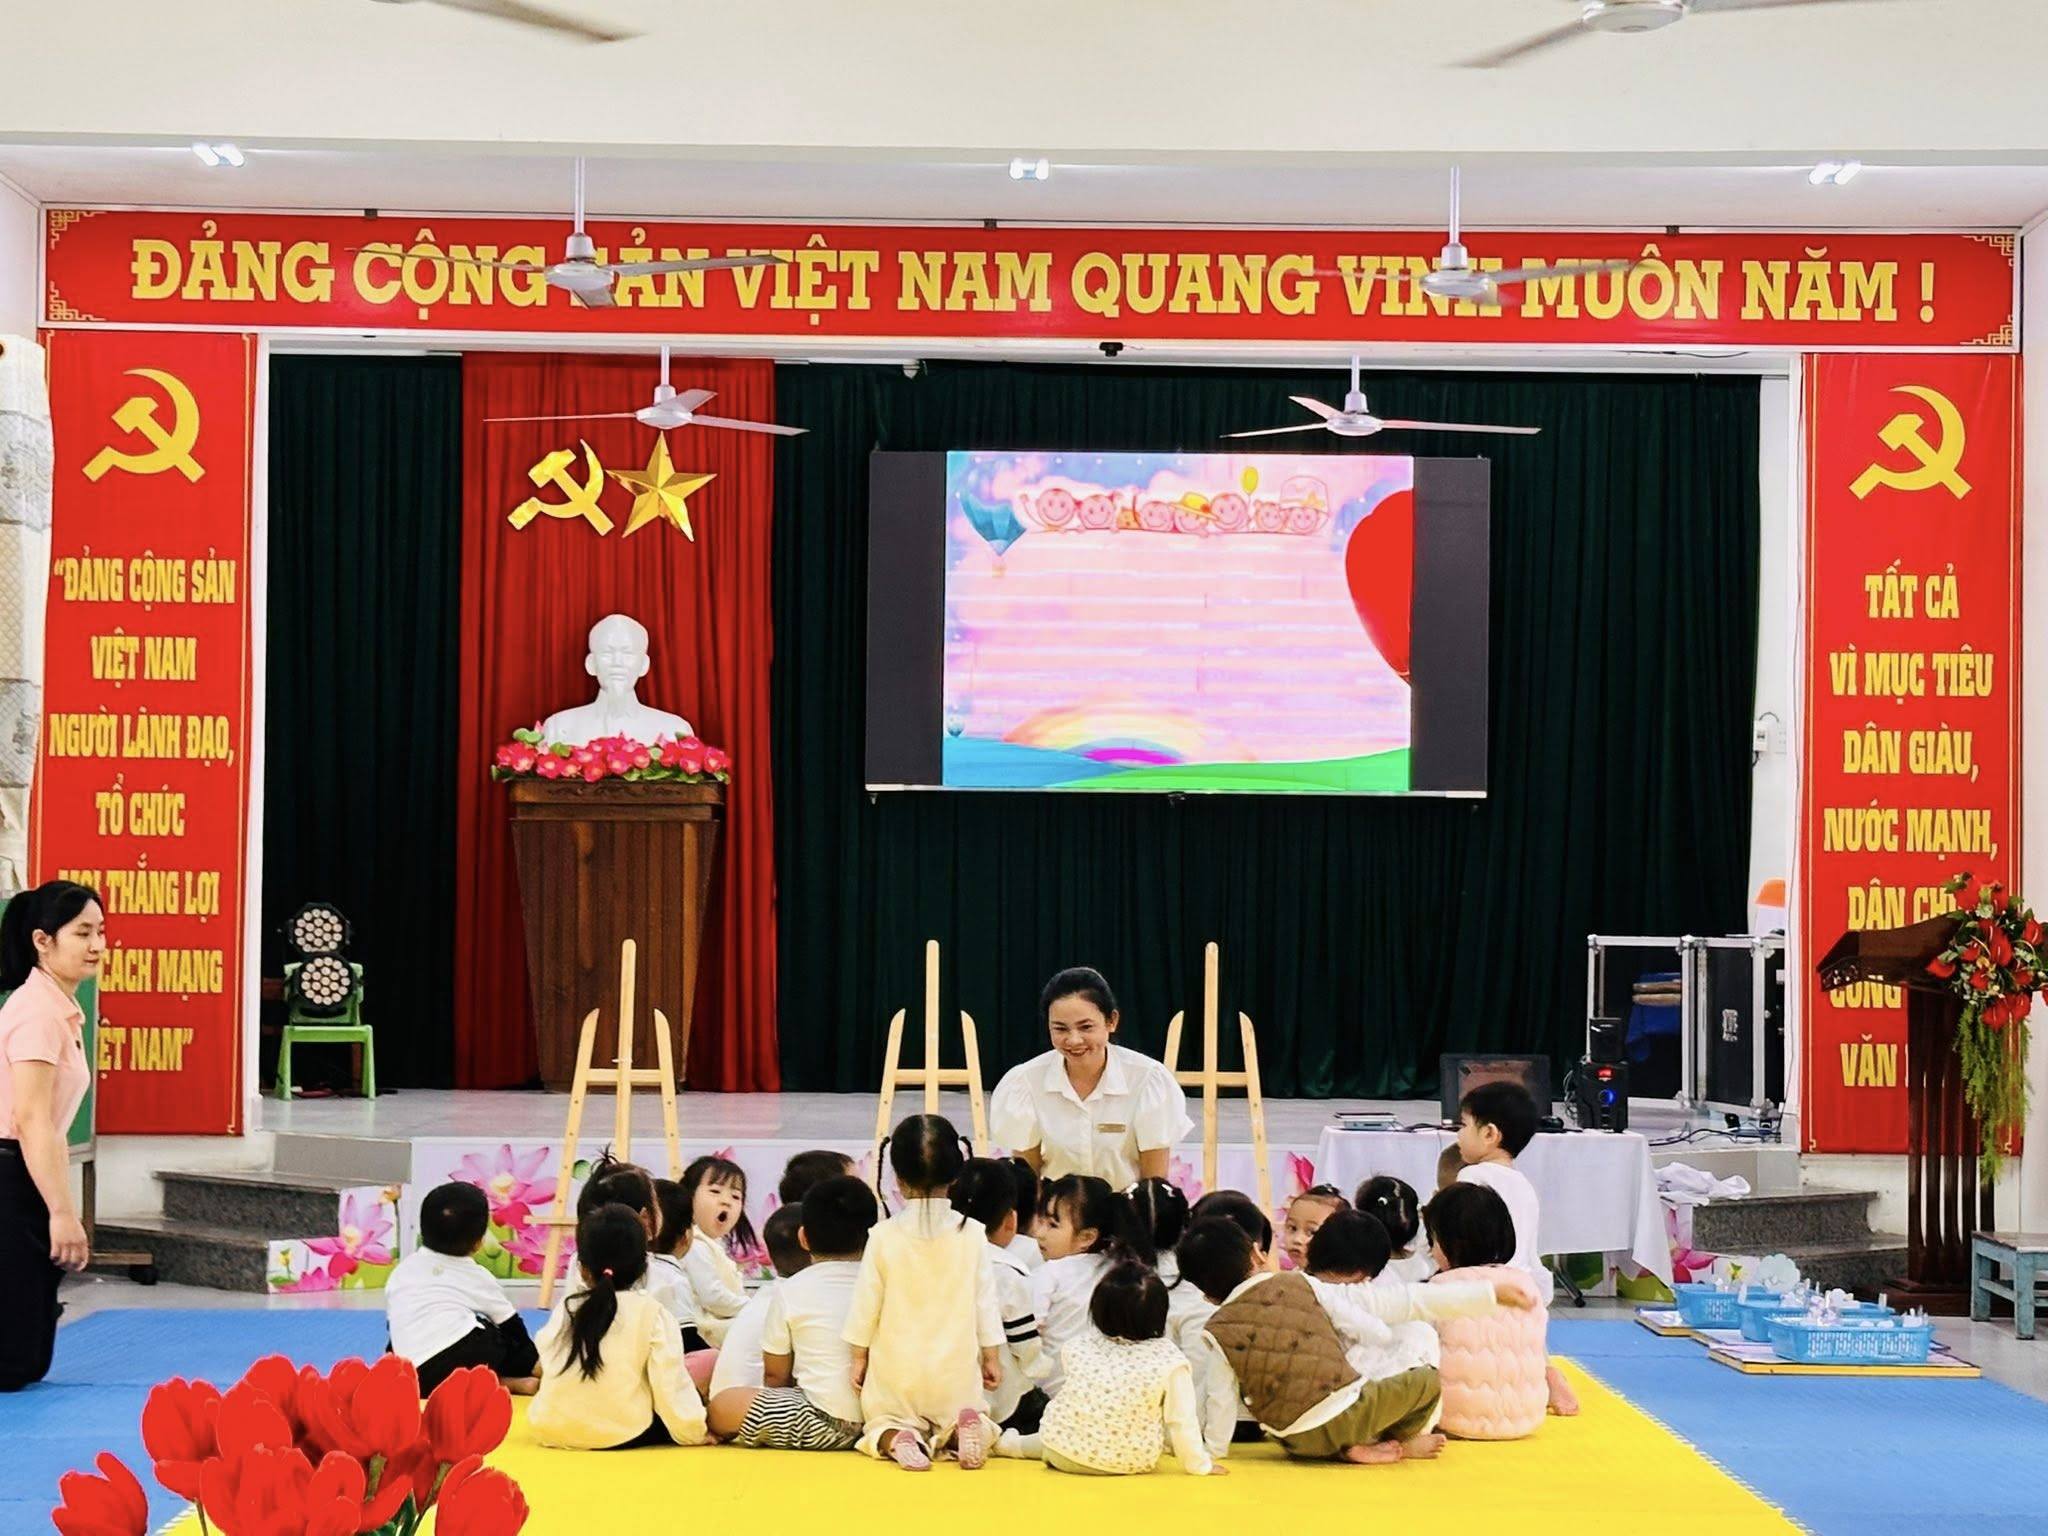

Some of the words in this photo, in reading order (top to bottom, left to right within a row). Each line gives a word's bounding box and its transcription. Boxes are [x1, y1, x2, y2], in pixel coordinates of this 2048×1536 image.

[131, 219, 335, 303] ĐẢNG
[353, 228, 548, 320] CỘNG
[727, 233, 879, 326] VIỆT
[898, 251, 1053, 313] NAM
[1071, 252, 1322, 318] QUANG
[1520, 243, 1723, 322] MUÔN
[1740, 246, 1898, 322] NĂM
[130, 550, 186, 611] CỘNG
[191, 547, 236, 604] SẢN
[1865, 559, 1918, 619] TẤT
[1925, 563, 1960, 619] CẢ
[91, 626, 139, 688] VIỆT
[144, 637, 197, 681] NAM
[1830, 643, 1858, 696] VÌ
[1864, 652, 1925, 704] MỤC
[1932, 643, 1994, 697] TIÊU
[49, 705, 118, 758] NGƯỜI
[186, 715, 234, 767] ĐẠO,
[1843, 721, 1901, 774] DÂN
[1908, 722, 1979, 783] GIÀU,
[96, 773, 124, 835] TỔ
[130, 784, 185, 837] CHỨC
[1824, 799, 1899, 852] NƯỚC
[1906, 809, 1998, 861] MẠNH,
[106, 853, 179, 915] THẮNG
[184, 871, 220, 923] LỢI
[1847, 877, 1906, 931] DÂN
[1913, 887, 1957, 924] CH
[99, 940, 153, 993] CÁCH
[157, 949, 223, 1001] MẠNG
[99, 1018, 127, 1080] ỆT
[1840, 1033, 1898, 1087] VĂN
